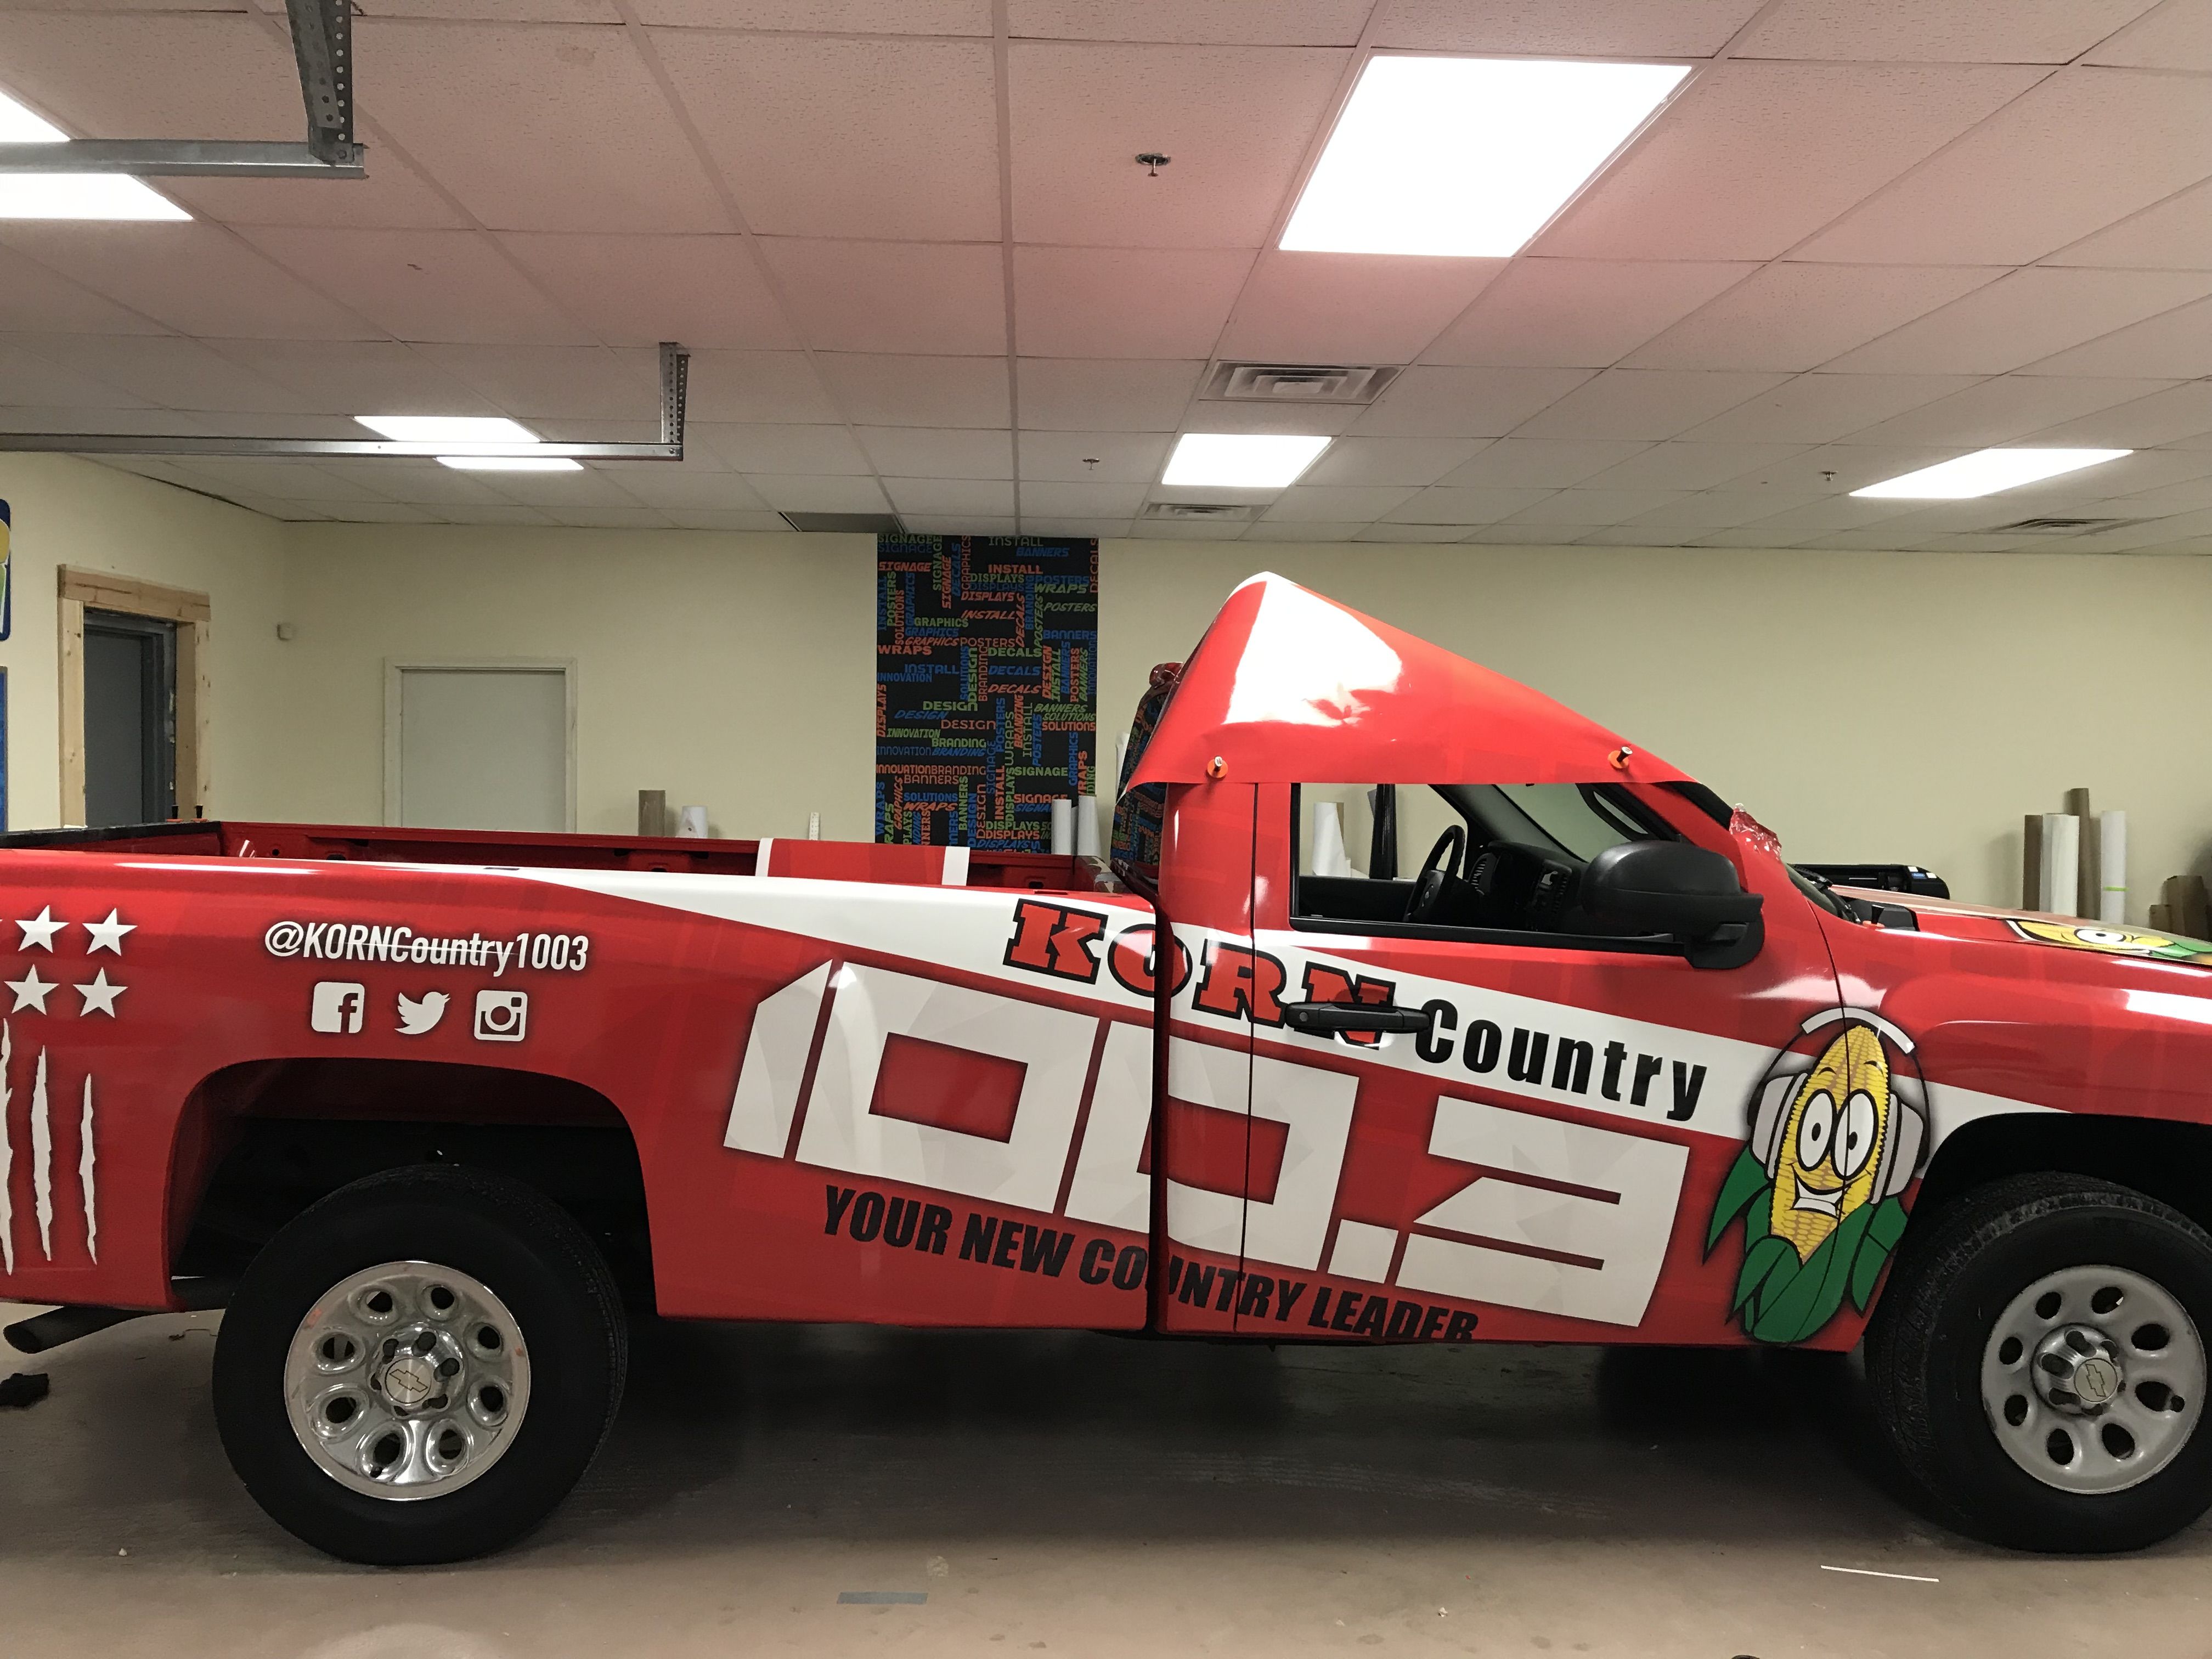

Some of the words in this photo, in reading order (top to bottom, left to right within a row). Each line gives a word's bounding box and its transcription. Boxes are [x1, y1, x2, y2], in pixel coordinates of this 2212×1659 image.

[878, 534, 933, 544] SIGNAGE
[988, 537, 1043, 546] INSTALL
[878, 544, 933, 553] SIGNAGE
[1016, 547, 1070, 557] BANNERS
[878, 562, 932, 571] SIGNAGE
[933, 535, 942, 591] SIGNAGE
[961, 535, 971, 590] GRAPHICS
[951, 543, 961, 597] DECALS
[988, 564, 1043, 574] INSTALL
[941, 555, 951, 609] SIGNAGE
[970, 573, 1024, 583] DISPLAYS
[1035, 575, 1089, 584] POSTERS
[970, 582, 1024, 591] DISPLAYS
[1035, 584, 1088, 594] WRAPS
[887, 571, 896, 627] POSTERS
[905, 572, 915, 627] GRAPHICS
[961, 591, 1015, 601] DISPLAYS
[878, 576, 887, 631] INSTALL
[1025, 574, 1034, 630] BRANDING
[1044, 602, 1097, 612] POSTERS
[895, 590, 904, 645] SOLUTIONS
[961, 610, 1015, 619] INSTALL
[1015, 592, 1025, 647] DECALS
[915, 617, 969, 628] GRAPHICS
[1034, 594, 1043, 648] POSTERS
[905, 627, 959, 636] GRAPHICS
[1043, 630, 1097, 639] BANNERS
[905, 636, 959, 646] GRAPHICS
[960, 637, 1015, 647] POSTERS
[878, 645, 932, 655] WRAPS
[988, 647, 1042, 657] DECALS
[904, 664, 960, 674] INSTALL
[988, 665, 1042, 675] DECALS
[1042, 645, 1052, 699] DESIGN
[1061, 641, 1071, 694] BANNERS
[878, 673, 932, 682] INNOVATION
[960, 646, 969, 700] SOLUTIONS
[968, 647, 977, 702] DESIGN
[978, 646, 988, 702] BRANDING
[1052, 648, 1061, 702] INSTALL
[1070, 647, 1080, 702] POSTERS
[1079, 647, 1088, 702] BANNERS
[988, 684, 1042, 693] DECALS
[877, 683, 887, 737] DISPLAYS
[923, 701, 978, 711] DESIGN
[1034, 703, 1088, 712] BANNERS
[894, 710, 949, 719] DESIGN
[1042, 713, 1096, 721] SOLUTIONS
[941, 719, 996, 730] DESIGN
[996, 698, 1006, 753] POSTERS
[1014, 693, 1024, 748] BRANDING
[1023, 702, 1032, 757] INSTALL
[1042, 721, 1096, 731] SOLUTIONS
[887, 728, 941, 738] INNOVATION
[1005, 711, 1014, 765] WRAPS
[932, 738, 986, 748] BRANDING
[1032, 713, 1042, 766] POSTERS
[877, 746, 932, 756] INNOVATION
[933, 748, 985, 757] BRANDING
[1068, 732, 1078, 786] GRAPHICS
[876, 764, 931, 774] INNOVATION
[931, 765, 986, 775] BRANDING
[987, 741, 996, 794] SIGNAGE
[1015, 768, 1068, 776] SIGNAGE
[1078, 750, 1088, 795] RAPS
[904, 775, 959, 785] BANNERS
[904, 792, 958, 802] SOLUTIONS
[995, 765, 1005, 820] INSTALL
[1006, 767, 1015, 821] DISPLAYS
[876, 781, 885, 835] WRAPS
[894, 776, 903, 830] GRAPHICS
[904, 802, 957, 811] WRAPS
[959, 776, 968, 830] BANNERS
[977, 784, 986, 839] DESIGN
[968, 793, 977, 848] DESIGN
[986, 821, 1040, 830] DISPLAYS
[986, 830, 1040, 839] DISPLAYS
[977, 839, 1030, 848] DISPLAYS
[264, 920, 590, 977] @KORNCountry1003
[1003, 898, 1396, 1050] KORN
[1414, 999, 1707, 1122] Country
[723, 958, 1690, 1328] 100.3
[825, 1184, 952, 1255] YOUR
[959, 1212, 1076, 1278] NEW
[1308, 1288, 1479, 1341] LEADER
